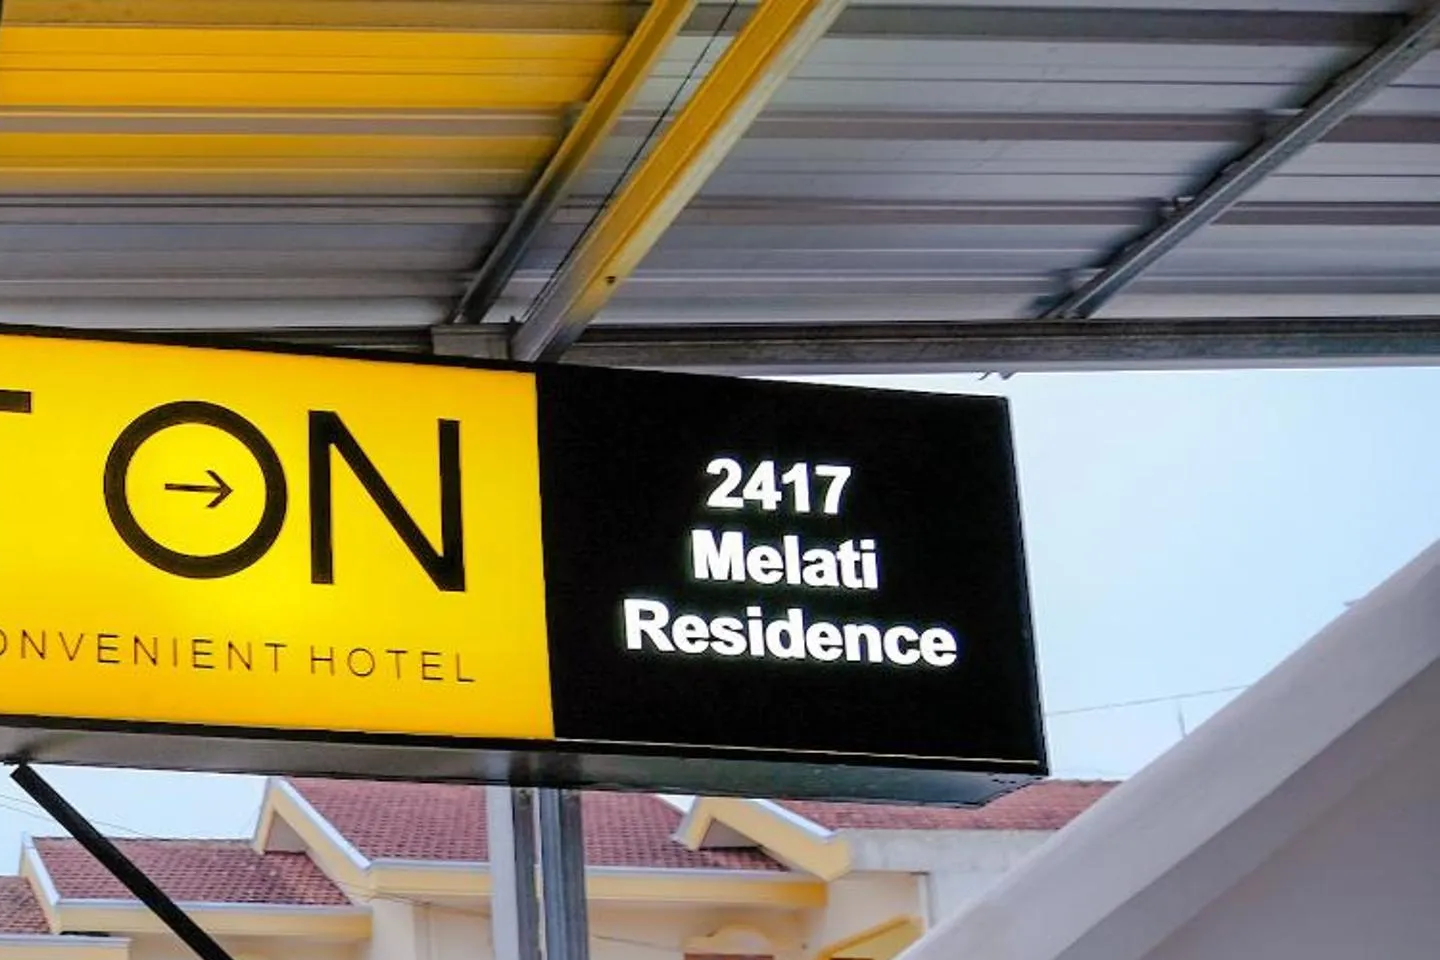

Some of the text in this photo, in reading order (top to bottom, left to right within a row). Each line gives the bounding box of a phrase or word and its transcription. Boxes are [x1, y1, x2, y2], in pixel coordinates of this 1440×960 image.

[102, 400, 467, 593] ON
[706, 458, 852, 515] 2417
[691, 529, 879, 590] Melati
[623, 598, 957, 667] Residence
[308, 645, 478, 684] HOTEL
